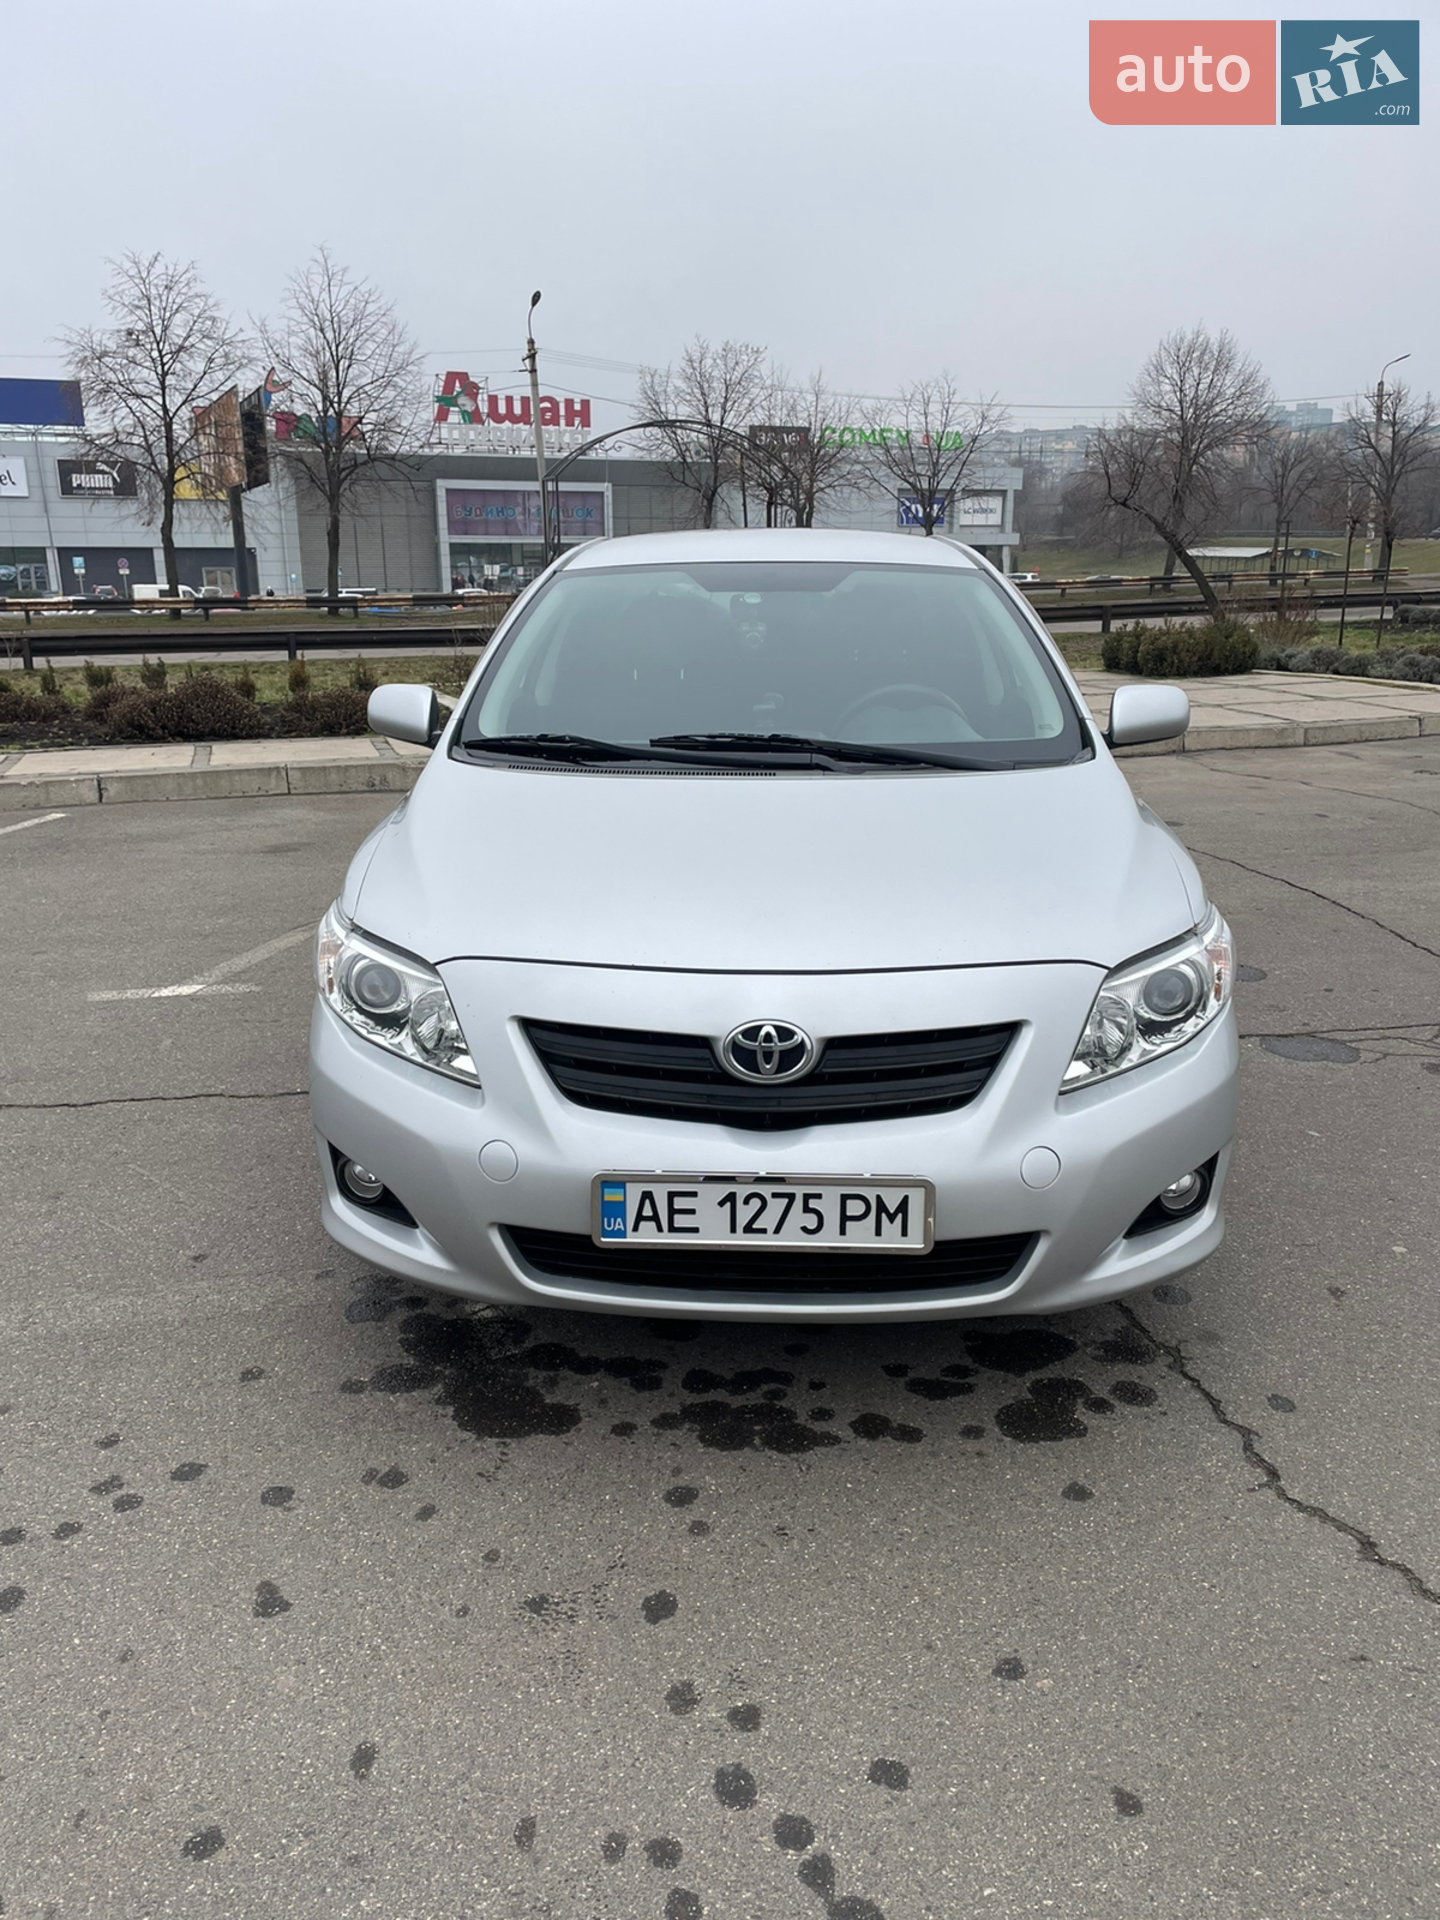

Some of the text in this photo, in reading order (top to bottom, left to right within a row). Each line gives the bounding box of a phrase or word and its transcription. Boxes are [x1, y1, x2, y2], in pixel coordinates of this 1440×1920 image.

[434, 371, 591, 428] Ашан
[71, 473, 114, 488] PUMA
[603, 1217, 625, 1231] UA
[632, 1190, 910, 1238] AE 1275 PM
